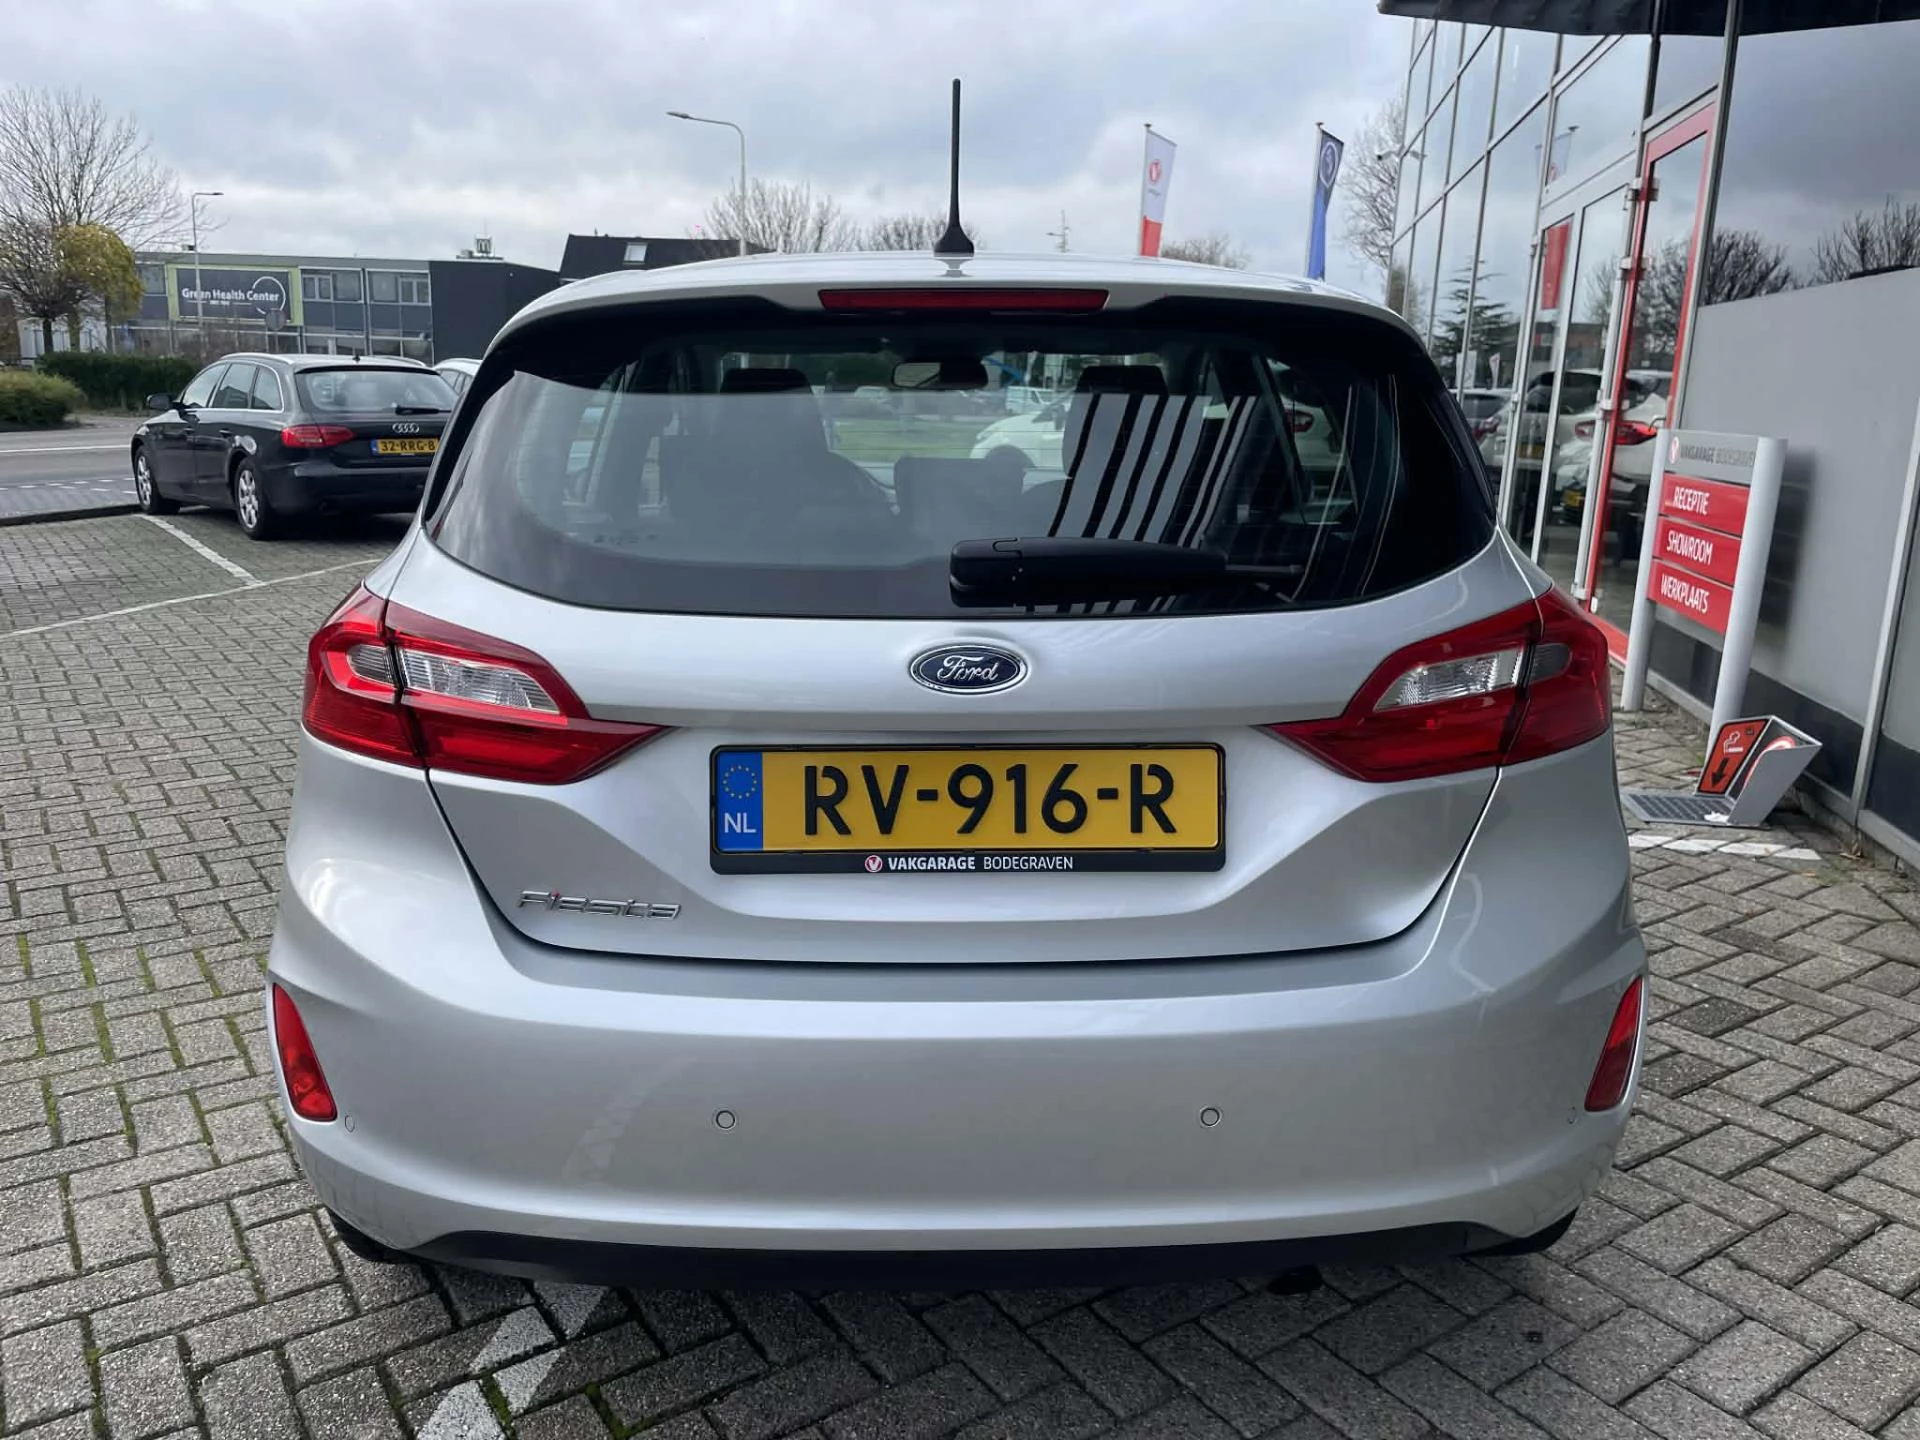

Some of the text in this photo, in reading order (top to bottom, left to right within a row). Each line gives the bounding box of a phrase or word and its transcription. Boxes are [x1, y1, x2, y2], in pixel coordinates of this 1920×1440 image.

[212, 288, 245, 300] Health
[246, 290, 279, 301] Center
[380, 440, 436, 452] 32-RRG-8
[1672, 486, 1710, 515] RECEPTIE
[1666, 530, 1713, 565] SHOWROOM
[1660, 573, 1710, 614] WERKPLAATS
[936, 655, 999, 681] Ford
[804, 763, 1177, 836] RV-916-R
[723, 812, 757, 833] NL
[888, 856, 976, 870] VAKGARAGE
[983, 856, 1073, 870] BODEGRAVEN
[517, 889, 682, 921] Fiesta
